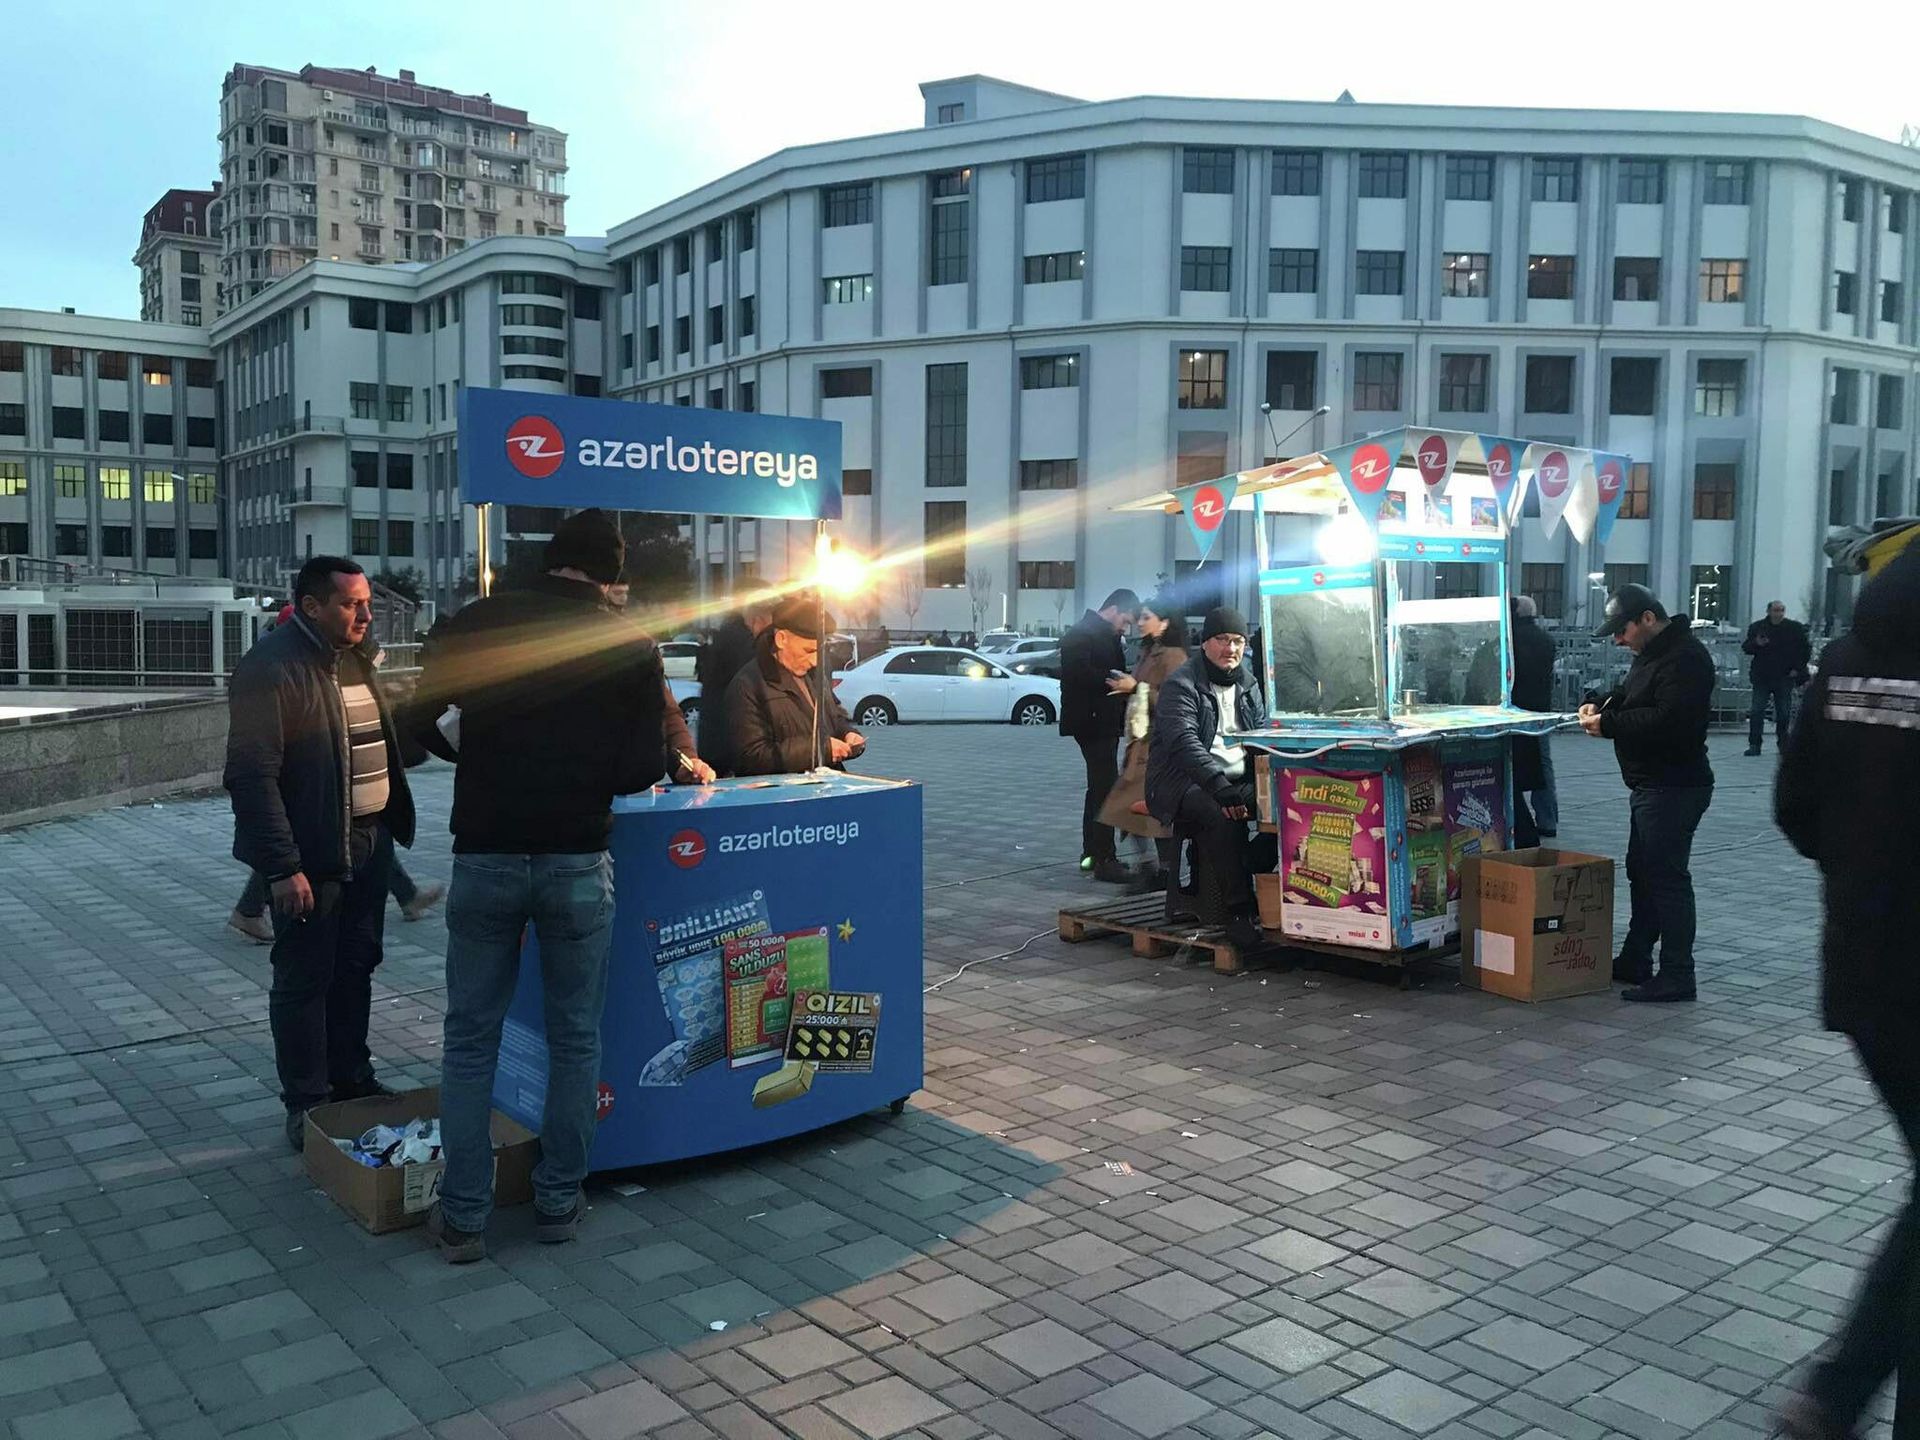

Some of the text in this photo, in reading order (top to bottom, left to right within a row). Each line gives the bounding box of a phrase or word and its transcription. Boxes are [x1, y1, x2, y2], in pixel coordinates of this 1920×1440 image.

[578, 436, 818, 488] azərlotereya
[1330, 784, 1350, 794] poz
[719, 821, 859, 853] azərlotereya
[659, 901, 758, 945] BRİLLİANT
[1553, 936, 1583, 957] Cups
[1566, 953, 1597, 970] Paper
[806, 993, 870, 1014] QIZIL
